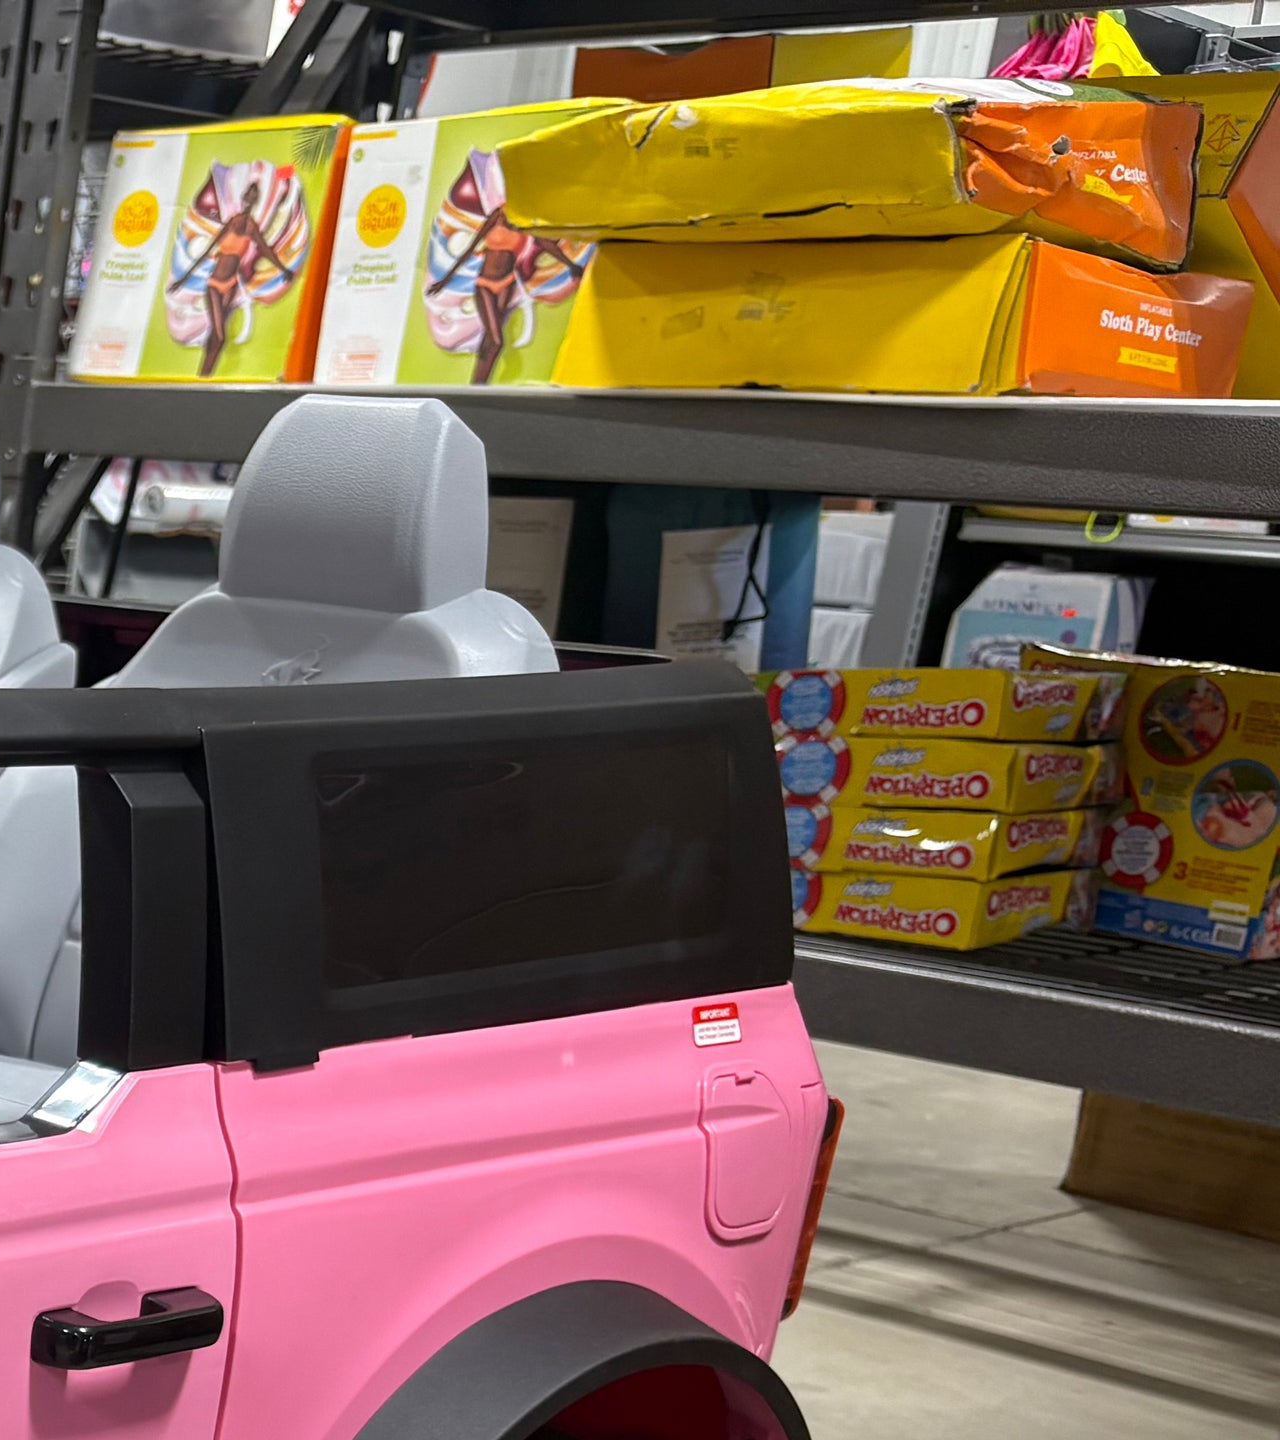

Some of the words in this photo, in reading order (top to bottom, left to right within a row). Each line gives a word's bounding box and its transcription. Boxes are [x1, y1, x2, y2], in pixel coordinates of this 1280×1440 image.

[1099, 309, 1133, 333] Sloth
[1136, 317, 1162, 342] Play
[1165, 323, 1202, 347] Center
[861, 701, 985, 727] OPERATION
[866, 772, 989, 800] OPERATION
[845, 843, 972, 870] OPERATION
[1174, 861, 1188, 880] 3
[836, 904, 957, 937] OPERATION
